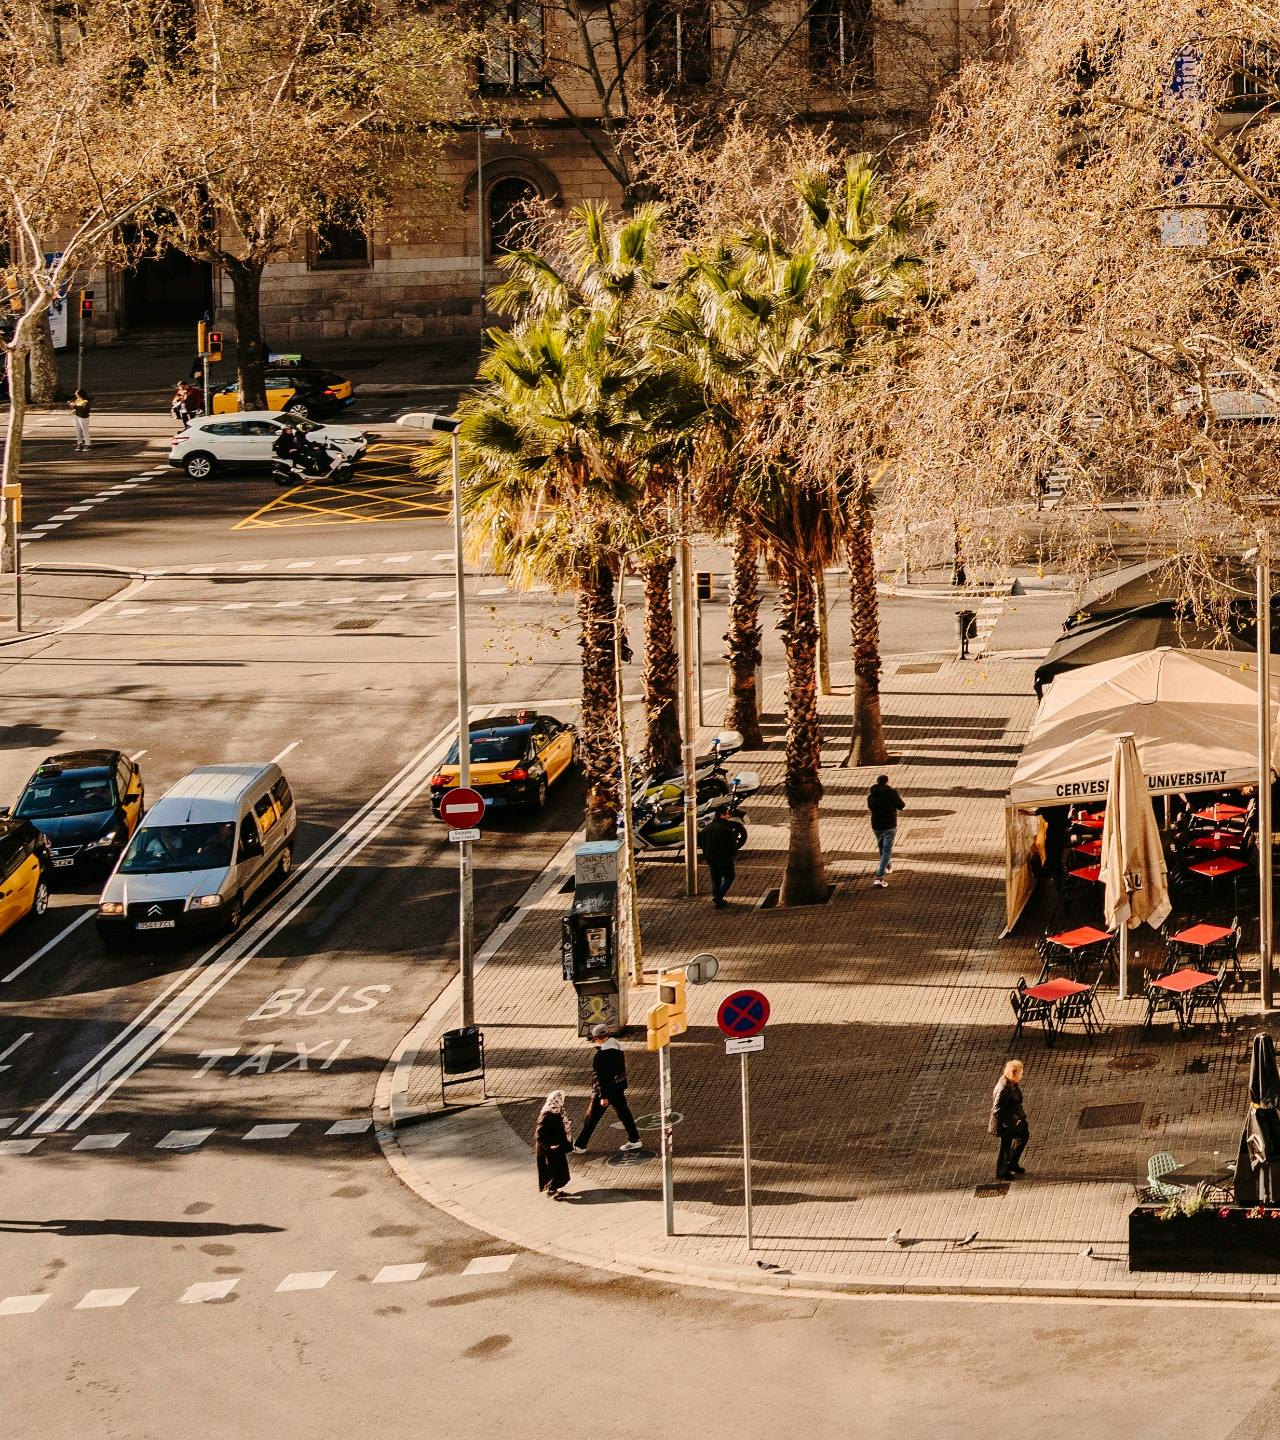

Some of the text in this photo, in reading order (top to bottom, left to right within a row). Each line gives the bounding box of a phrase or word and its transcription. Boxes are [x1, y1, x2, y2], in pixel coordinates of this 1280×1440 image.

[1148, 770, 1227, 789] UNIVERSITAT
[247, 984, 392, 1021] BUS
[191, 1038, 353, 1079] TAXI
